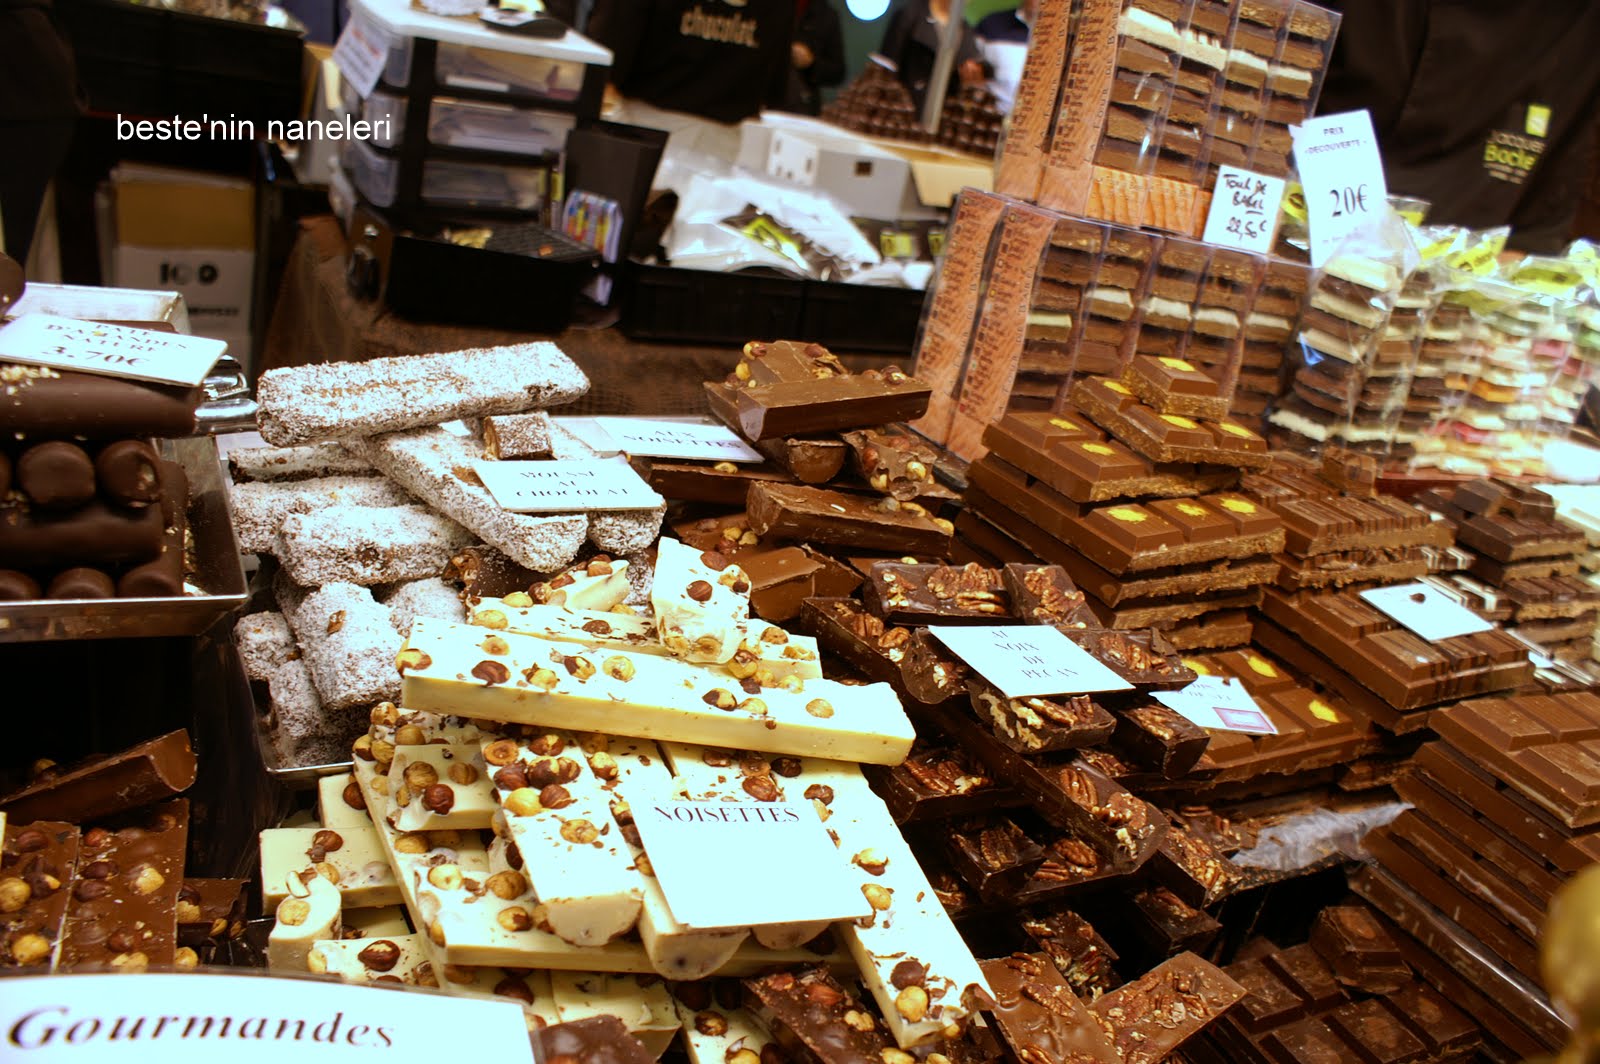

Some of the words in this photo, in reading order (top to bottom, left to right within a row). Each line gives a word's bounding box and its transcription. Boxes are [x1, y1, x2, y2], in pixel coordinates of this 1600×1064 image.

[1323, 126, 1345, 136] PRIX
[1330, 183, 1369, 217] 20€
[42, 344, 151, 368] 3.70€
[516, 488, 629, 498] CHOCOLAT
[653, 806, 801, 823] NOISETTES
[6, 1004, 395, 1050] Gourmandes
